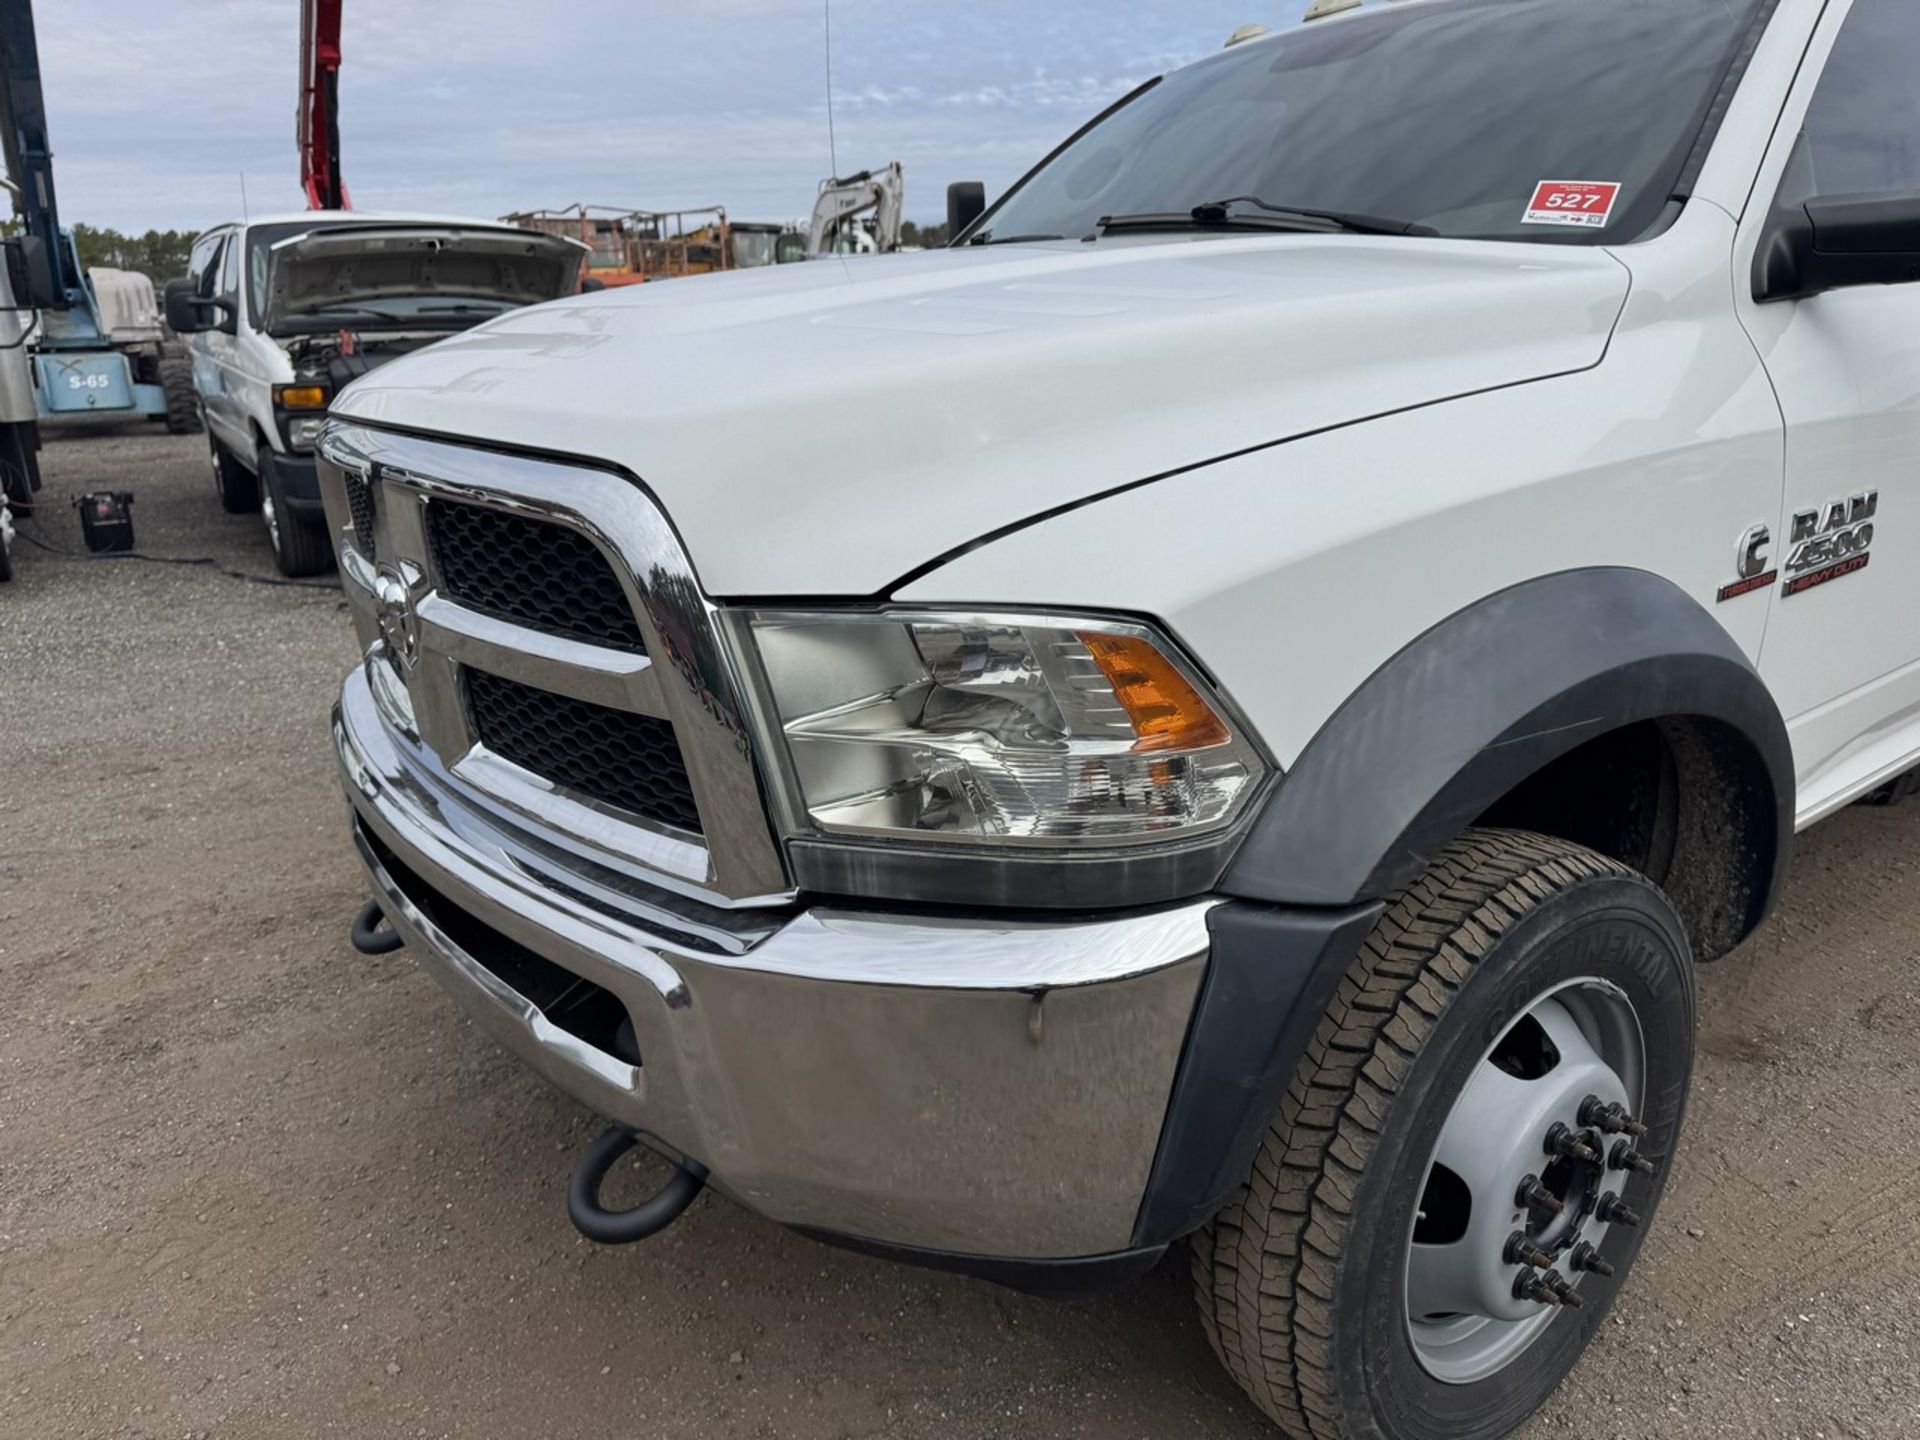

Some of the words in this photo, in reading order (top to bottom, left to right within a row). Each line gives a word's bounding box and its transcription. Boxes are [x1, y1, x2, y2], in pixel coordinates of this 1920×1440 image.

[1545, 193, 1601, 209] 527
[69, 374, 109, 389] S-65
[1790, 488, 1878, 544] RAM
[1784, 520, 1874, 573] 4500
[1790, 567, 1831, 593] HEAVY
[1834, 556, 1868, 576] DUTY
